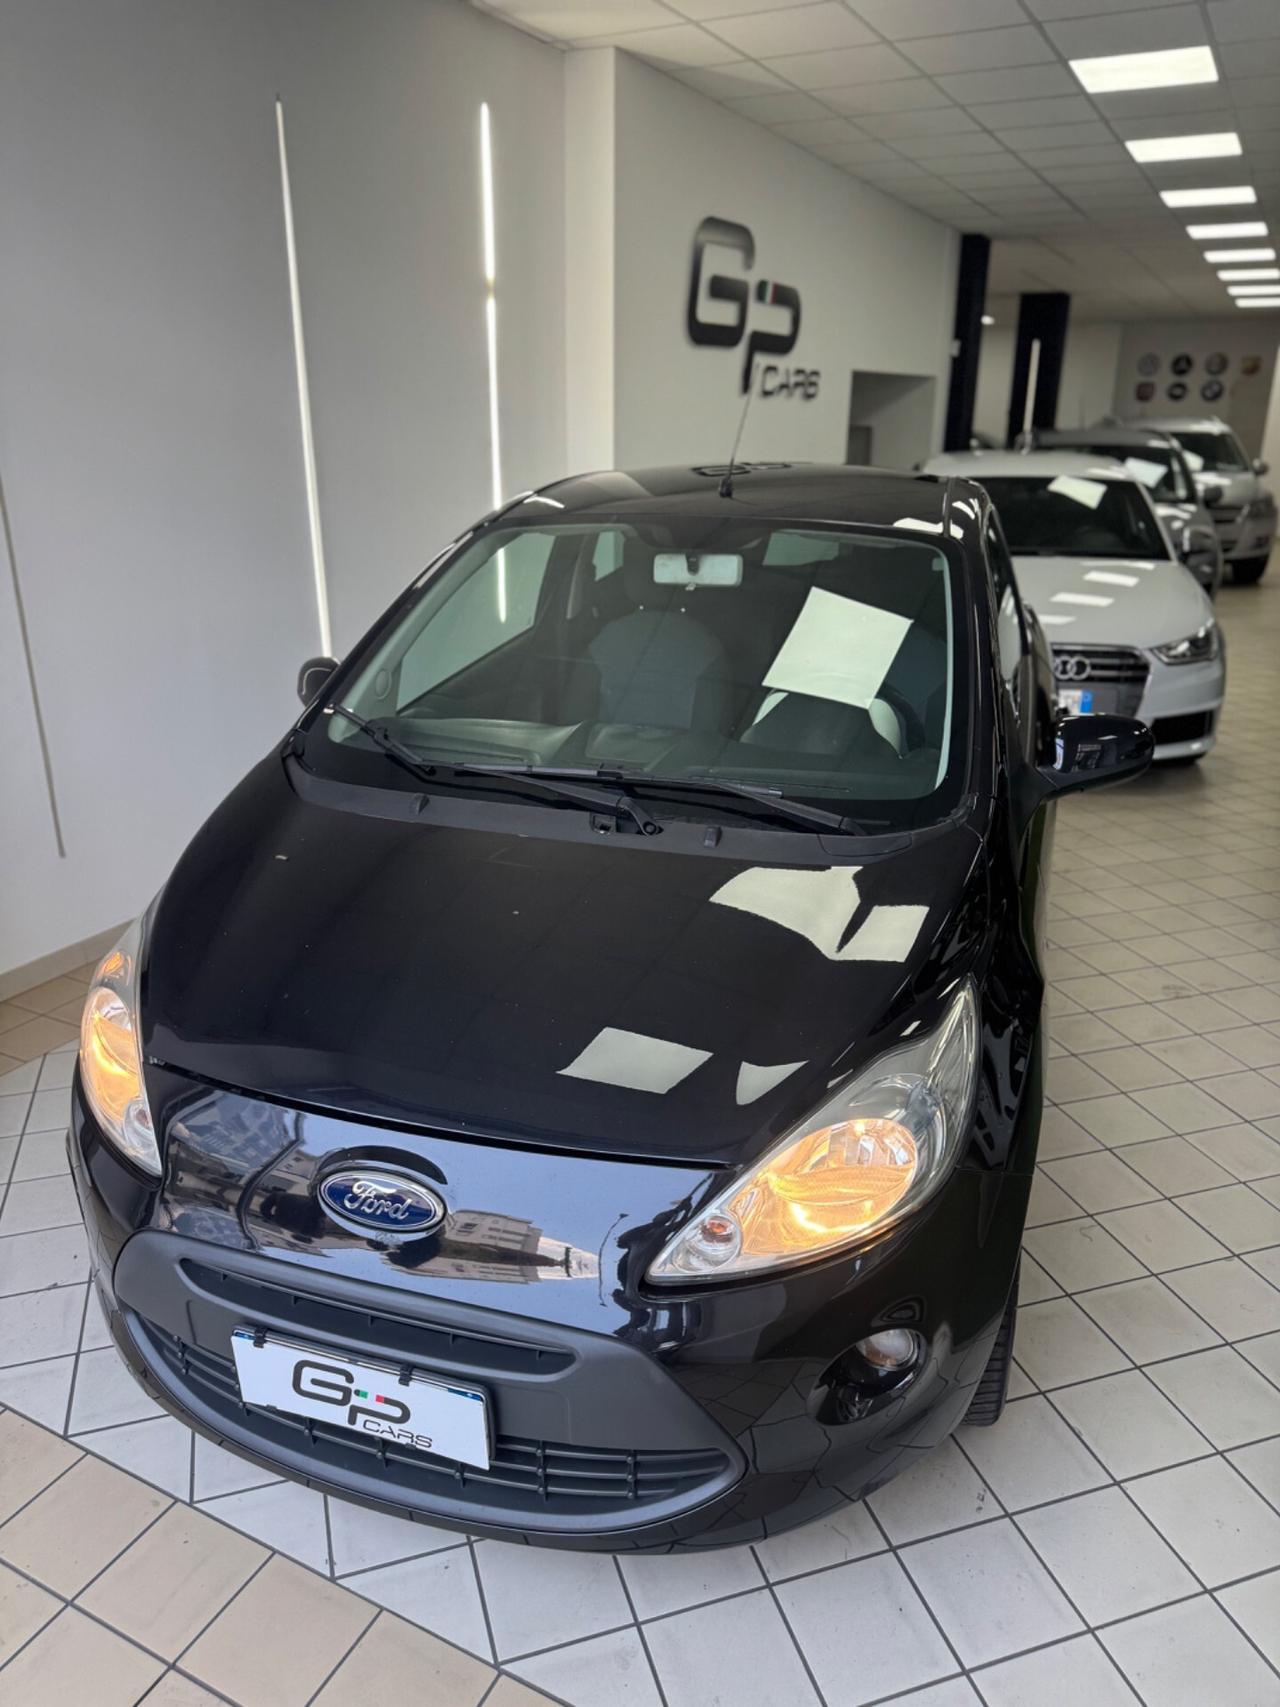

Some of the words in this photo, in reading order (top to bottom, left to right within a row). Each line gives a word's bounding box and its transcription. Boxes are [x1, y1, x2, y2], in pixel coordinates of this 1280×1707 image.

[688, 216, 801, 395] GP
[761, 365, 820, 399] CARS
[343, 1181, 412, 1219] Ford
[292, 1360, 411, 1425] GP
[363, 1419, 433, 1449] CARS
